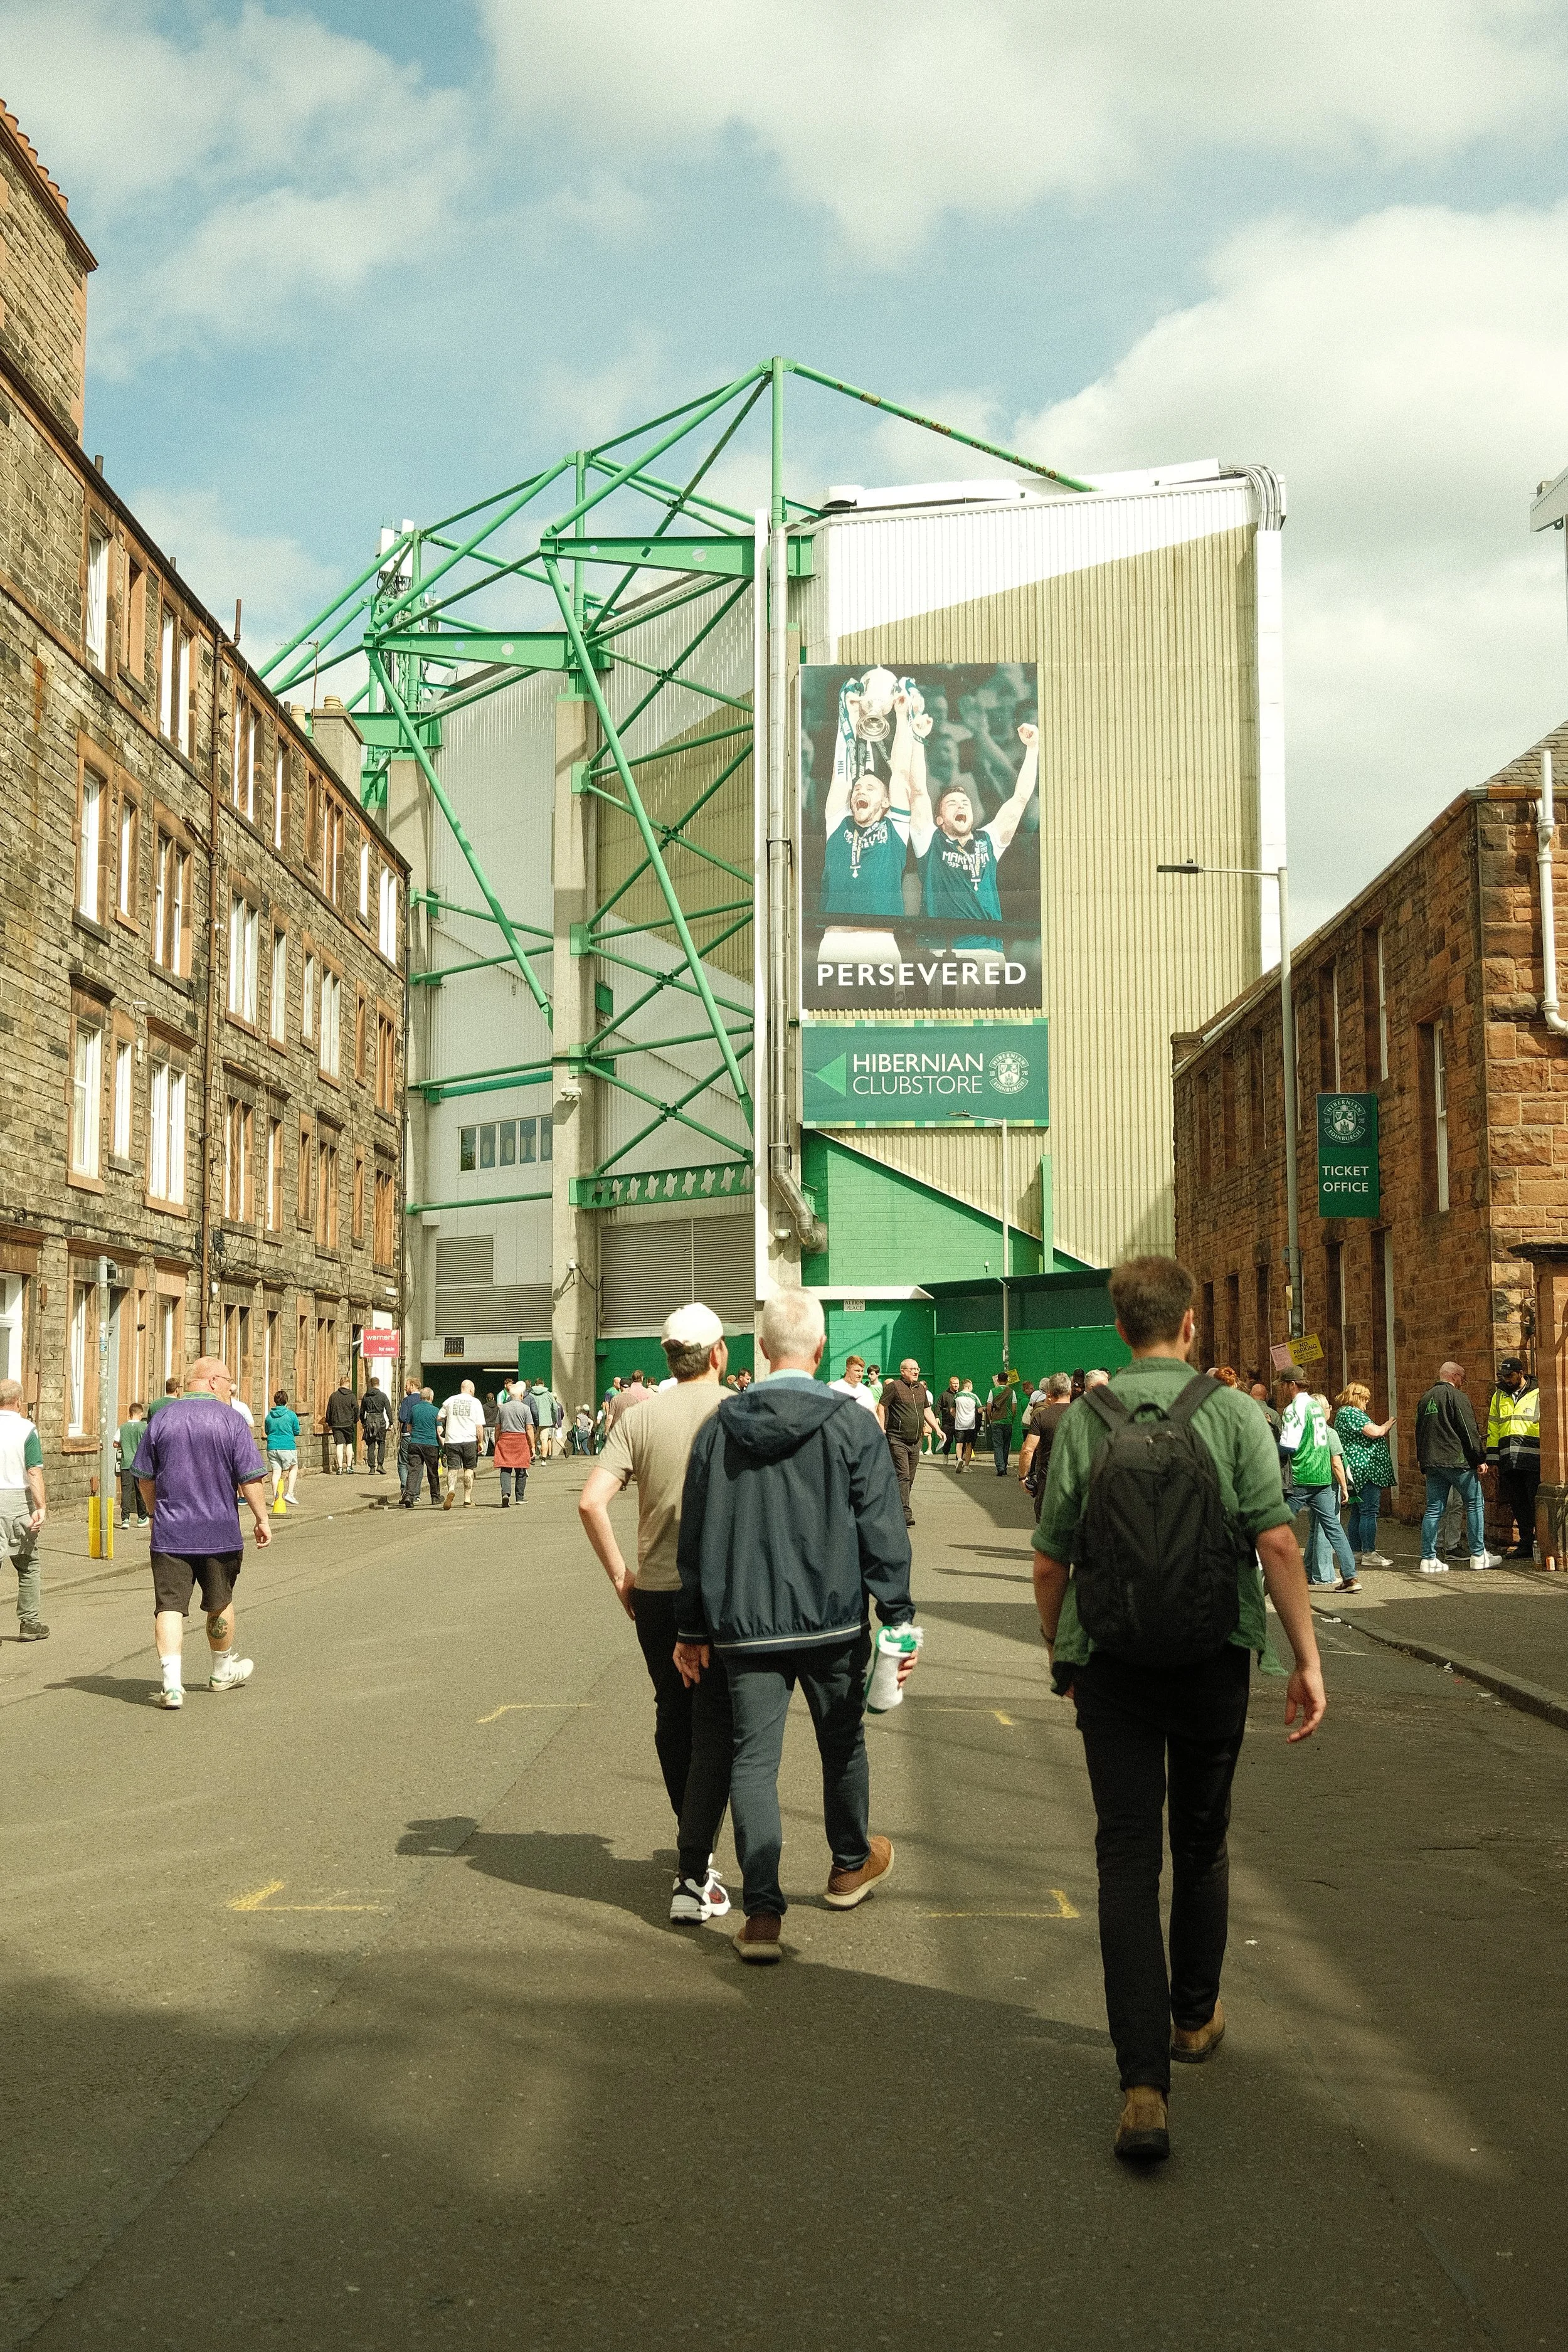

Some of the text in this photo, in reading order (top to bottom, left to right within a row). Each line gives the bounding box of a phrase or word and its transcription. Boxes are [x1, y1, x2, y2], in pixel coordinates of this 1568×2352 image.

[817, 963, 1026, 986] PERSEVERED
[853, 1053, 983, 1073] HIBERNIAN
[853, 1076, 983, 1094] CLUBSTORE
[1327, 1099, 1362, 1113] HIBERNIAN
[1328, 1130, 1362, 1141] EDINBURGH
[1322, 1165, 1369, 1176] TICKET
[1323, 1182, 1369, 1192] OFFICE
[1293, 1343, 1318, 1355] PARKING
[1312, 1416, 1327, 1446] 18
